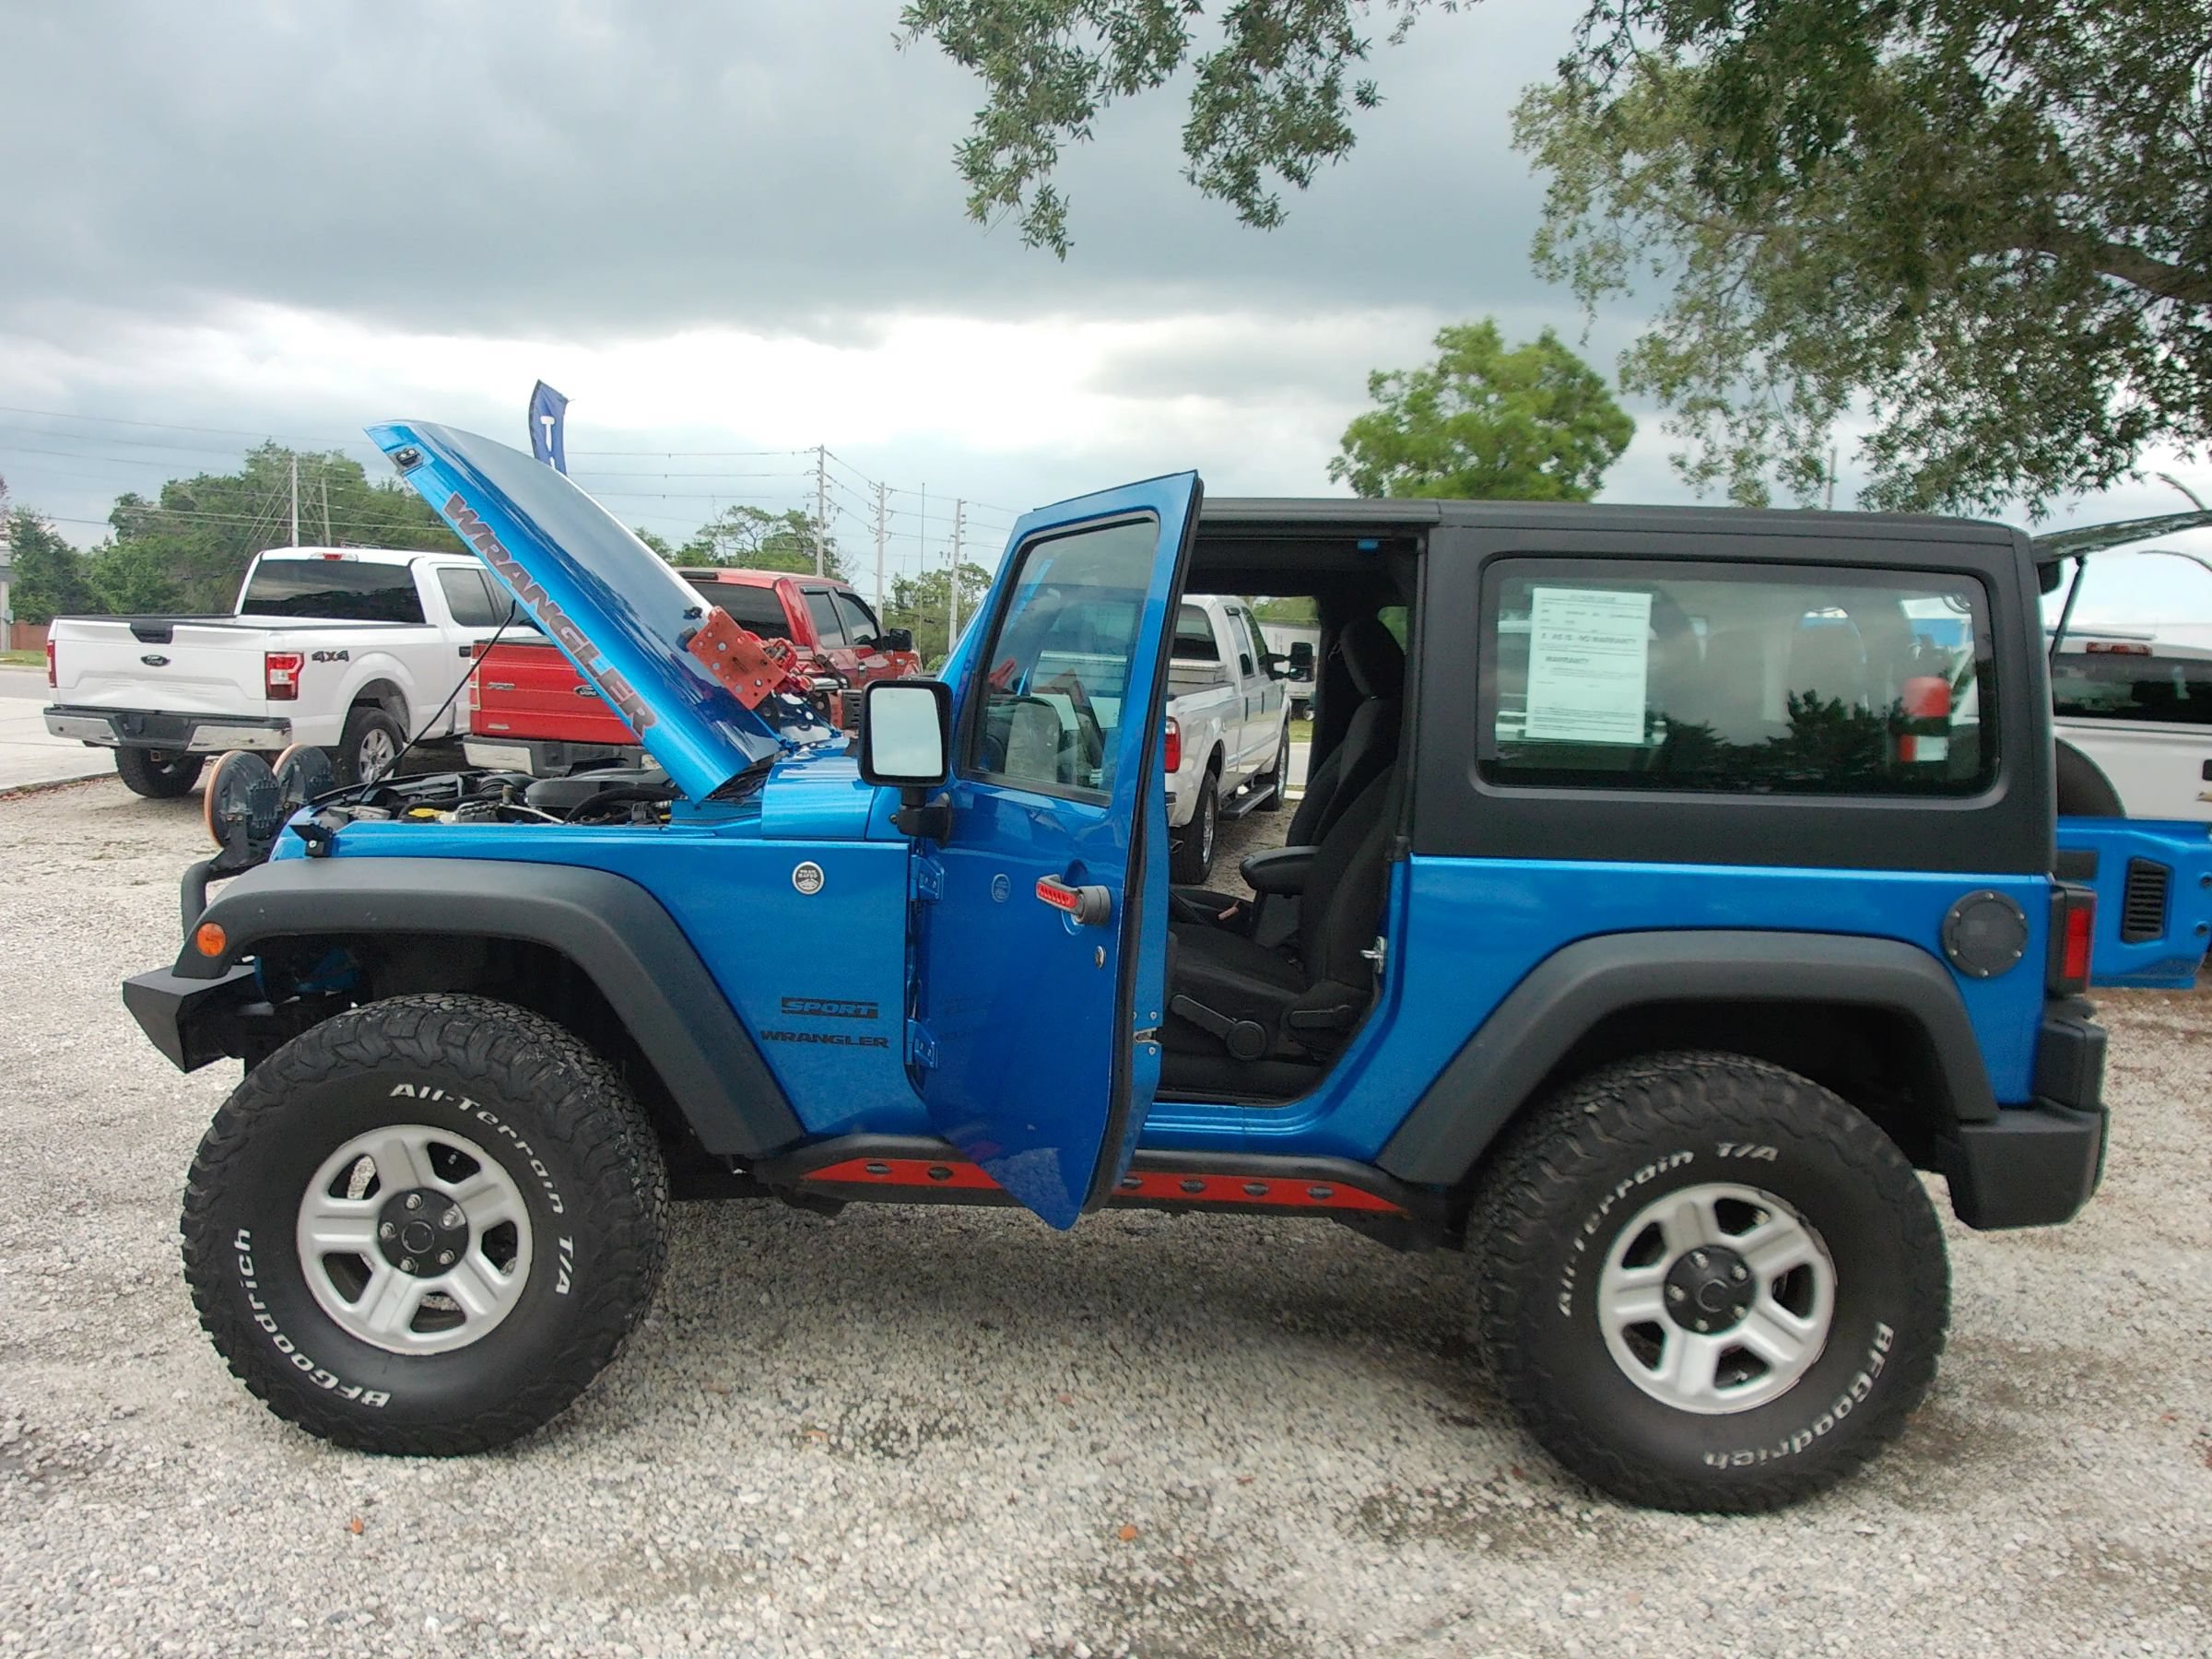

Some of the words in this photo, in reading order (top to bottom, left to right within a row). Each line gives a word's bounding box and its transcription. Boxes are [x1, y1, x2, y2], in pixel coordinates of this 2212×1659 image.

[442, 491, 658, 738] WRANGLER
[760, 1030, 889, 1048] WRANGLER
[782, 1001, 877, 1016] SPORT
[390, 1083, 565, 1214] All-Terrain
[556, 1236, 573, 1295] T/A
[1715, 1142, 1780, 1162] T/A
[234, 1228, 392, 1408] BFGoodrich
[1703, 1322, 1894, 1469] BFGoodrich
